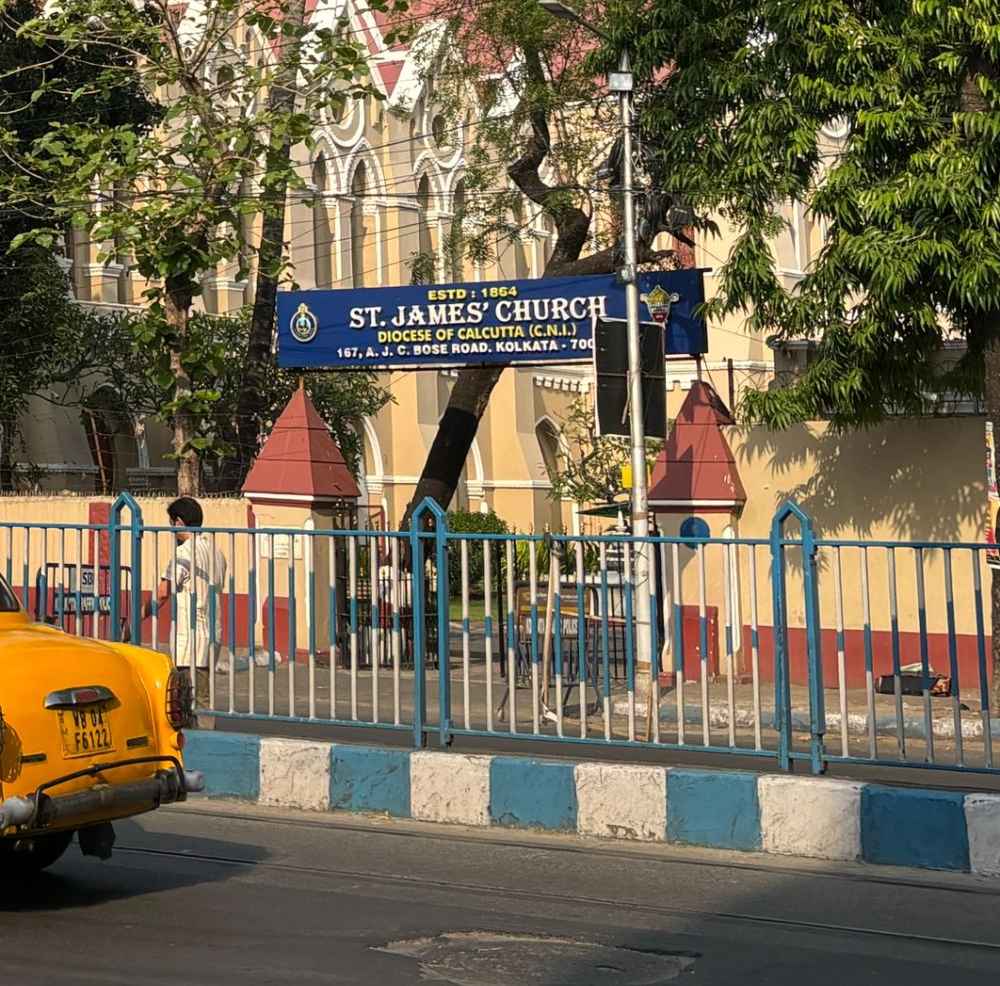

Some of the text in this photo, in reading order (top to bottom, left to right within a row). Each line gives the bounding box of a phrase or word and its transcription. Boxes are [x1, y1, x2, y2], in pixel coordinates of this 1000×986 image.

[427, 289, 467, 301] ESTD
[481, 286, 518, 298] 1864
[349, 306, 386, 328] ST.
[495, 296, 607, 322] CHURCH
[378, 322, 577, 343] DIOCESE OF CALCUTTA (C.N.I.)
[337, 347, 363, 359] 167,
[365, 346, 379, 358] A.
[381, 346, 394, 357] J.
[397, 344, 410, 356] C.
[413, 344, 448, 355] BOSE
[496, 340, 558, 352] KOLKATA
[74, 728, 110, 751] F6122
